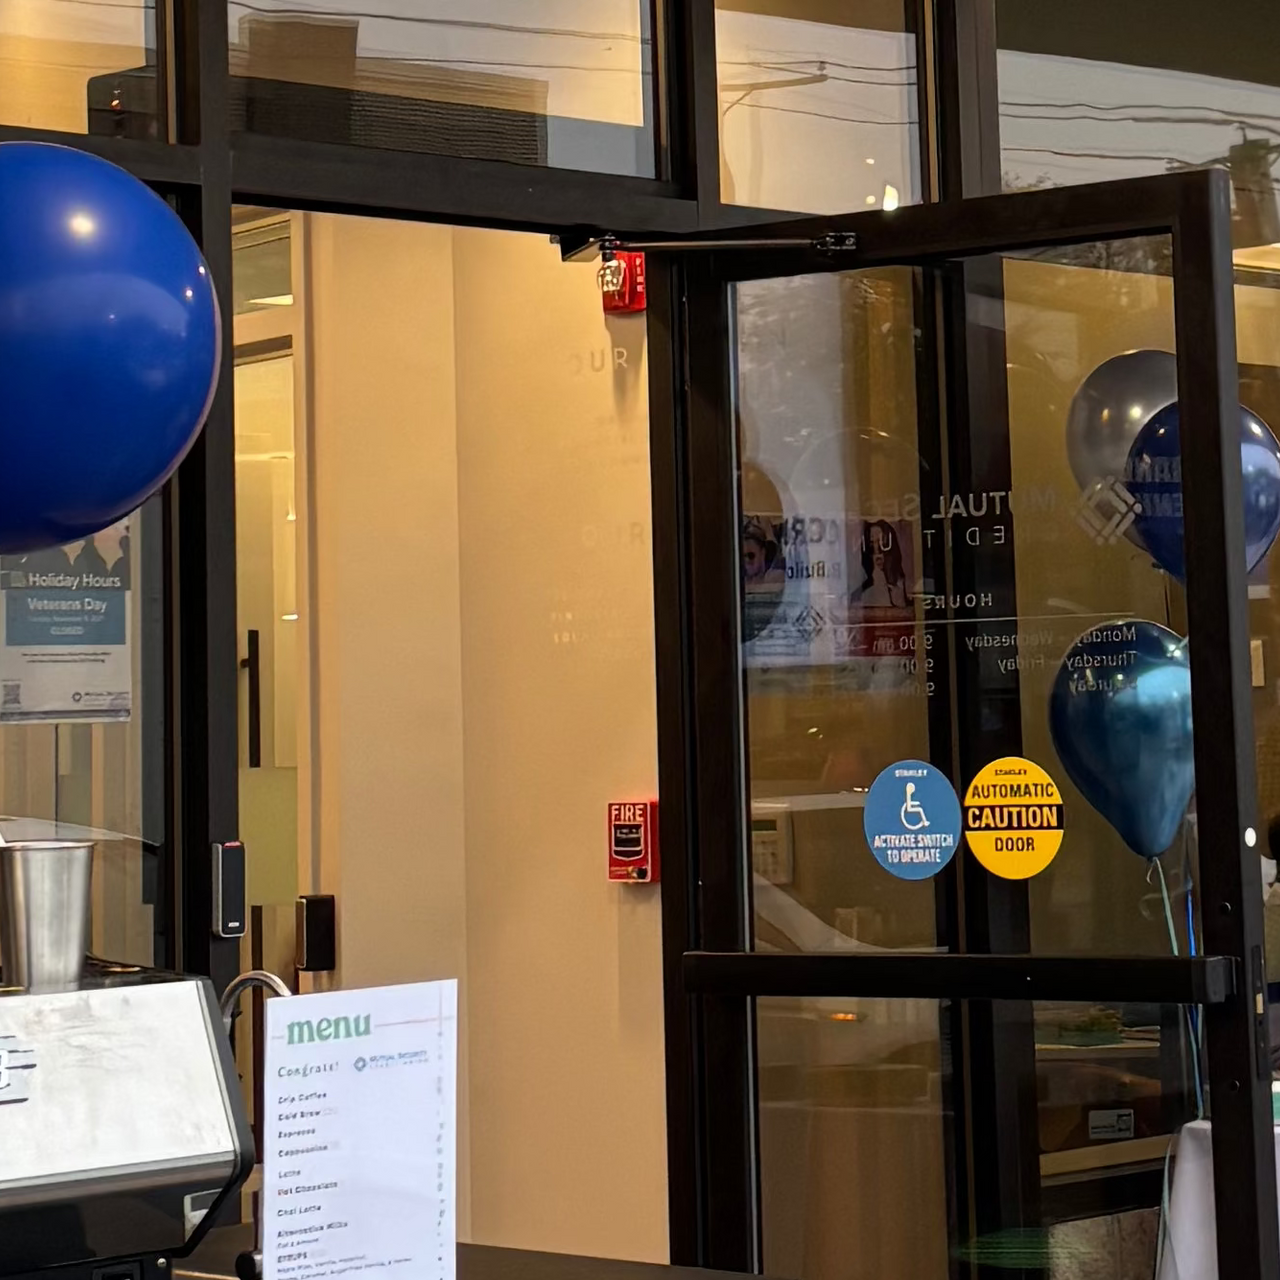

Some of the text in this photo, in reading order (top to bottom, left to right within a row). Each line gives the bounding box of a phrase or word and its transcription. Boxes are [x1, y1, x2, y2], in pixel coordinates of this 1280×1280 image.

[28, 572, 121, 589] Holiday Hours
[27, 598, 107, 614] Veterans Day
[972, 783, 1054, 799] AUTOMATIC
[611, 804, 644, 821] FIRE
[967, 806, 1058, 828] CAUTION
[874, 834, 954, 849] ACTIVATE SWITCH
[994, 837, 1035, 852] DOOR
[887, 849, 941, 863] TO OPERATE
[287, 1013, 371, 1045] menu
